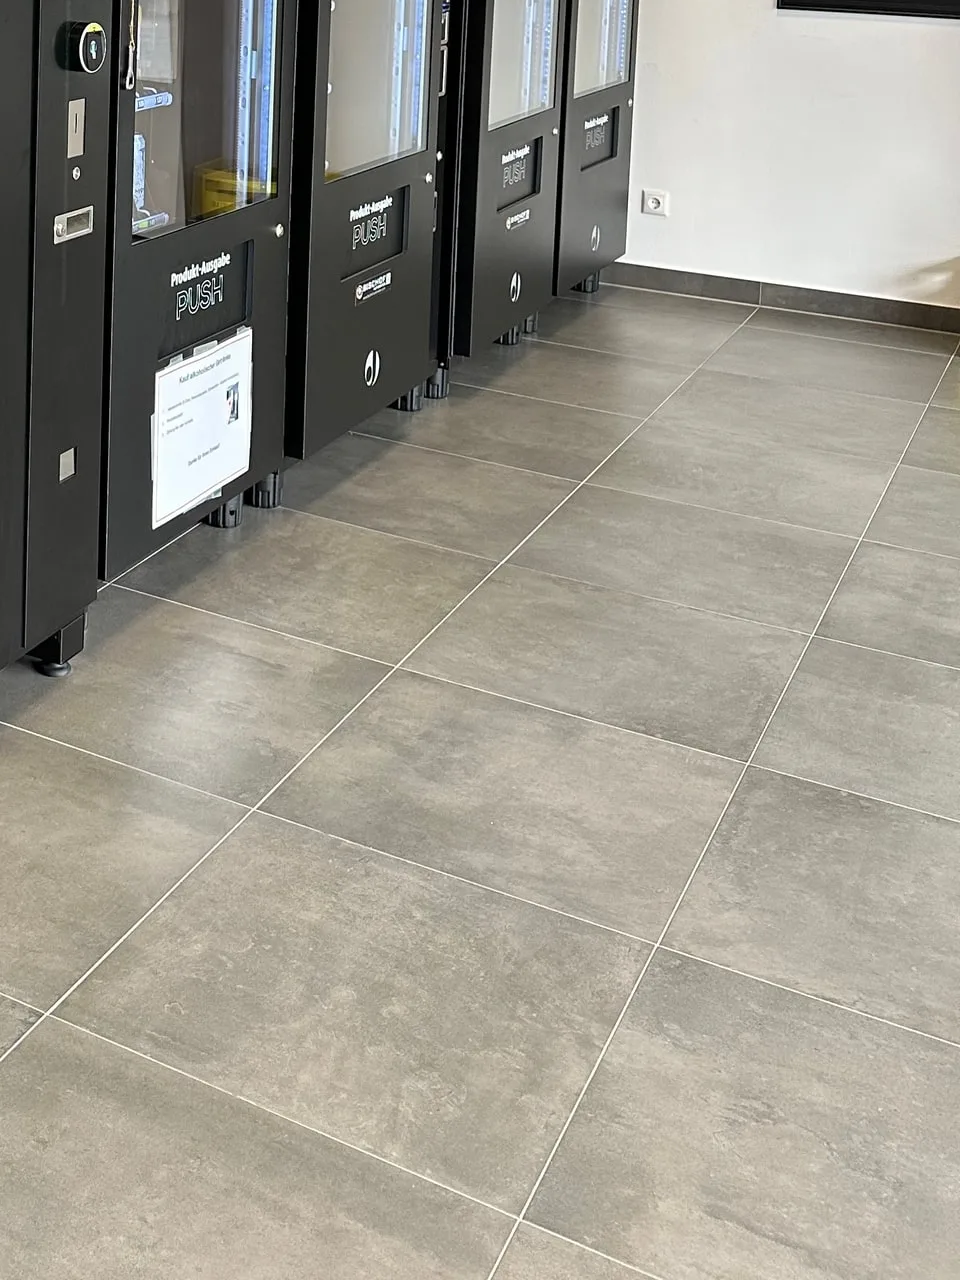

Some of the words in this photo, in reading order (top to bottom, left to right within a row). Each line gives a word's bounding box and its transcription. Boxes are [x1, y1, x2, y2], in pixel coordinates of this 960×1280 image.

[352, 213, 387, 250] PUSH
[170, 252, 231, 287] Produkt-Ausgabe
[175, 274, 224, 321] PUSH
